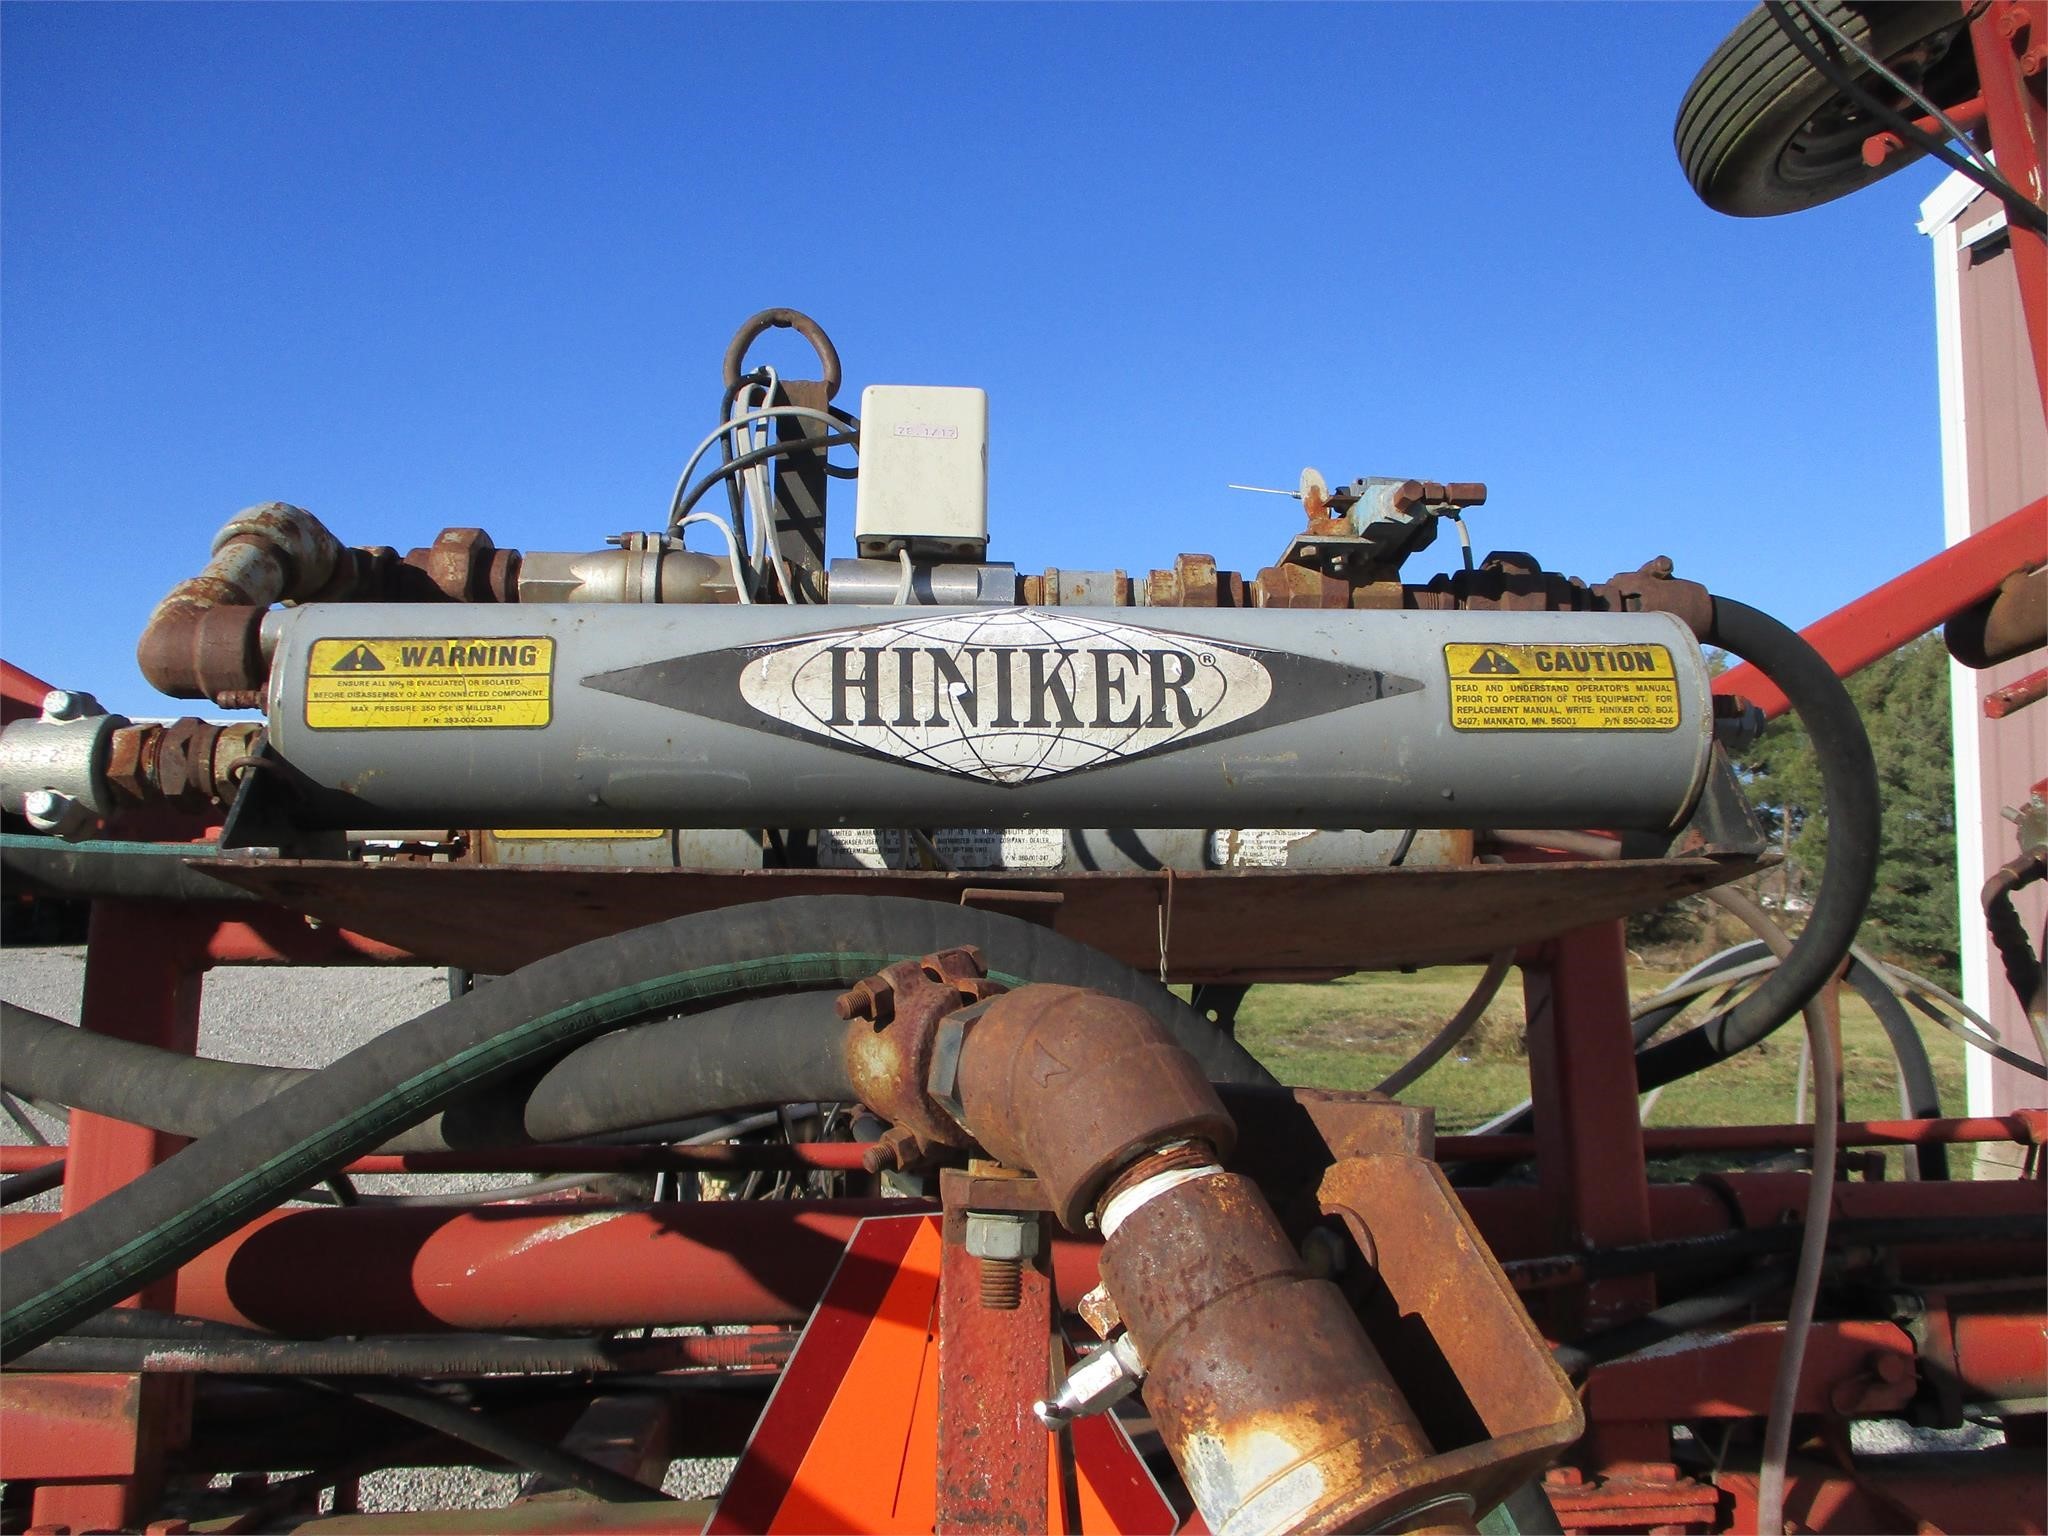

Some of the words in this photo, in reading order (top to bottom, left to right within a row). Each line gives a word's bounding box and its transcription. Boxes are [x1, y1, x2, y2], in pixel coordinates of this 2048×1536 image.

[401, 645, 537, 667] WARNING
[1535, 651, 1655, 672] CAUTION
[416, 679, 464, 687] EVACUATED
[825, 647, 1203, 729] HINIKER
[1597, 696, 1648, 704] EQUIPMENT.
[1457, 706, 1519, 714] REPLACEMENT
[1523, 706, 1561, 715] MANUAL,
[1566, 706, 1594, 714] WRITE:
[1600, 706, 1635, 714] HINIKER
[1638, 706, 1652, 714] CO.
[1656, 706, 1673, 714] BOX
[1484, 717, 1528, 725] MANKATO,
[1551, 717, 1576, 725] 56001
[1605, 717, 1620, 725] P/N
